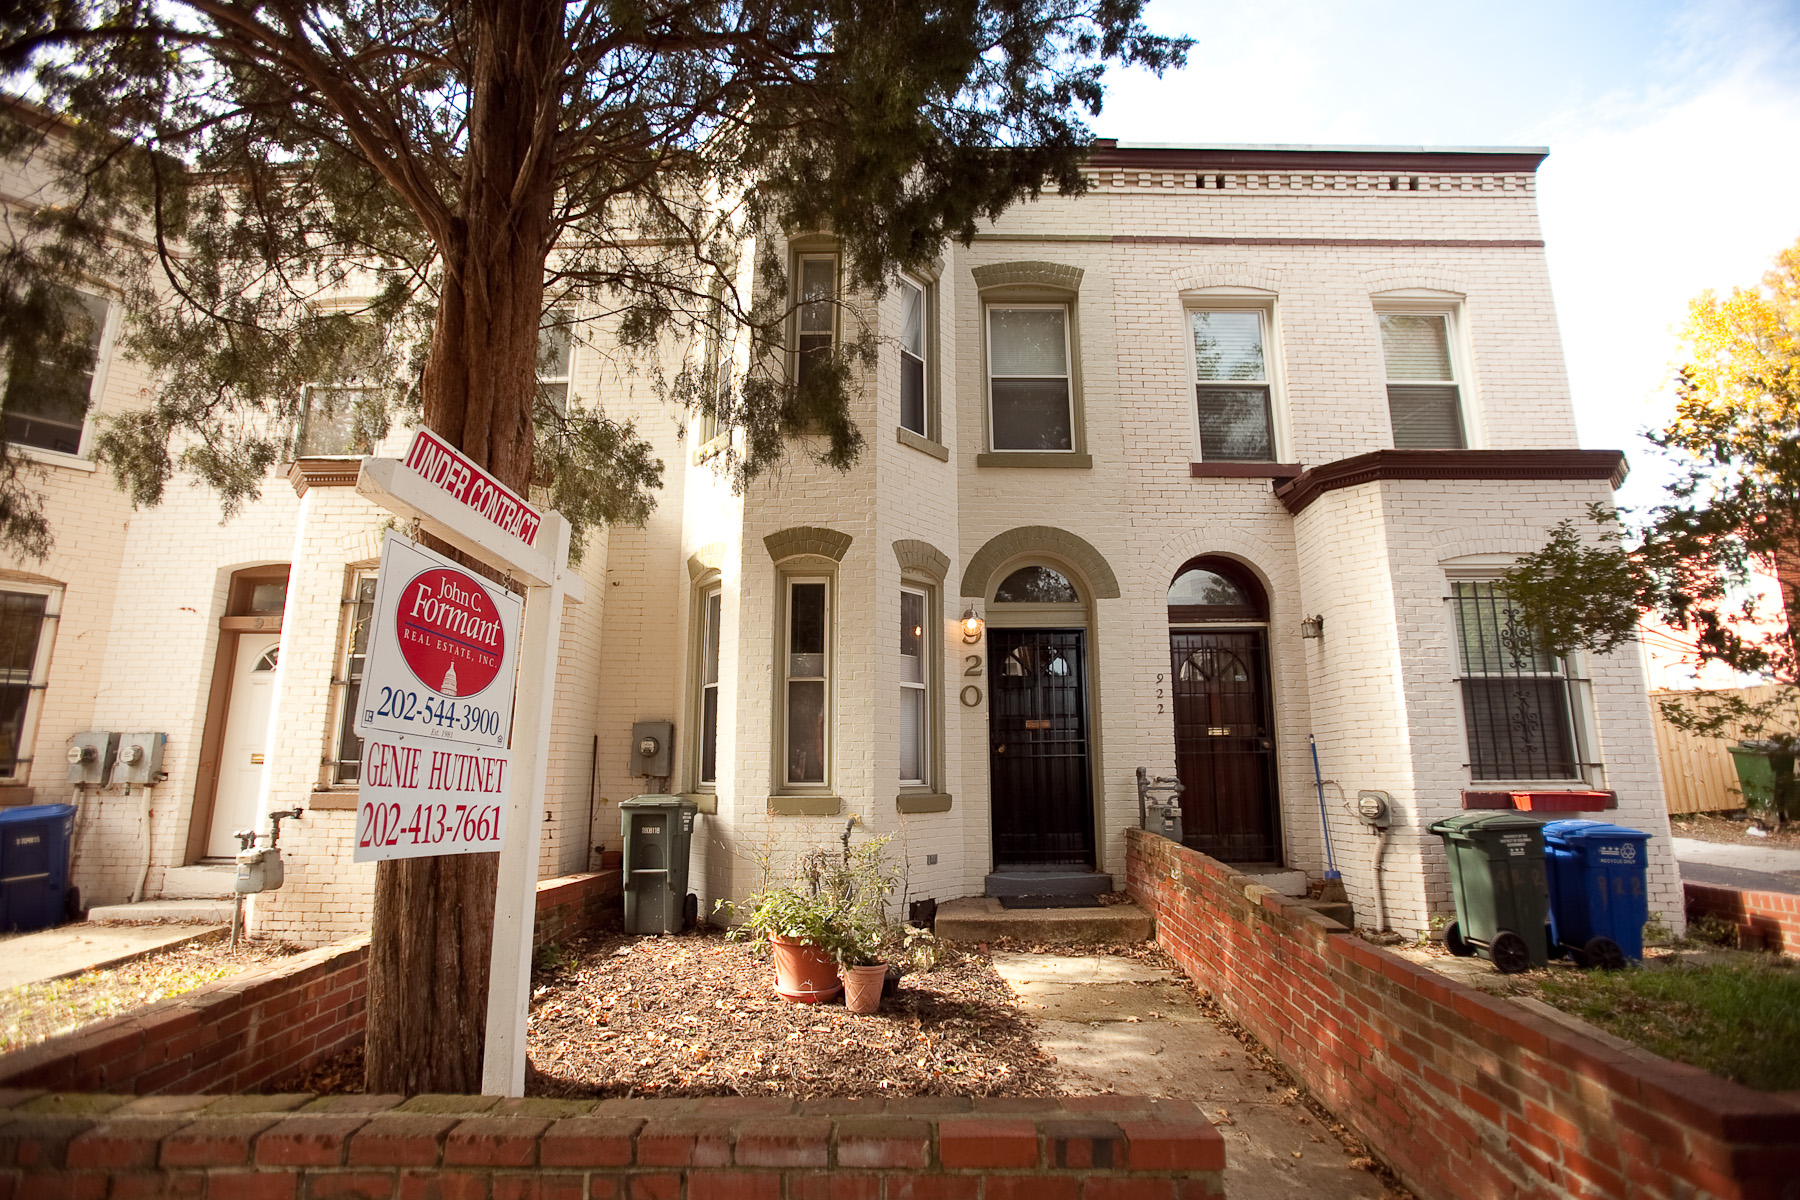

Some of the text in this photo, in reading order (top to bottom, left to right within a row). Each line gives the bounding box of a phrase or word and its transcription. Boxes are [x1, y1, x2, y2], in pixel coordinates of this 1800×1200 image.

[409, 436, 539, 545] UNDER CONTRACT
[409, 582, 501, 647] Formant
[437, 576, 482, 613] John C.
[403, 628, 498, 668] REAL ESTATE, INC.
[376, 686, 500, 736] 202-544-3900
[1155, 672, 1165, 715] 922
[430, 728, 454, 739] Est. 1981
[366, 741, 508, 794] GENIE HUTINET
[359, 801, 501, 848] 202-413-7661
